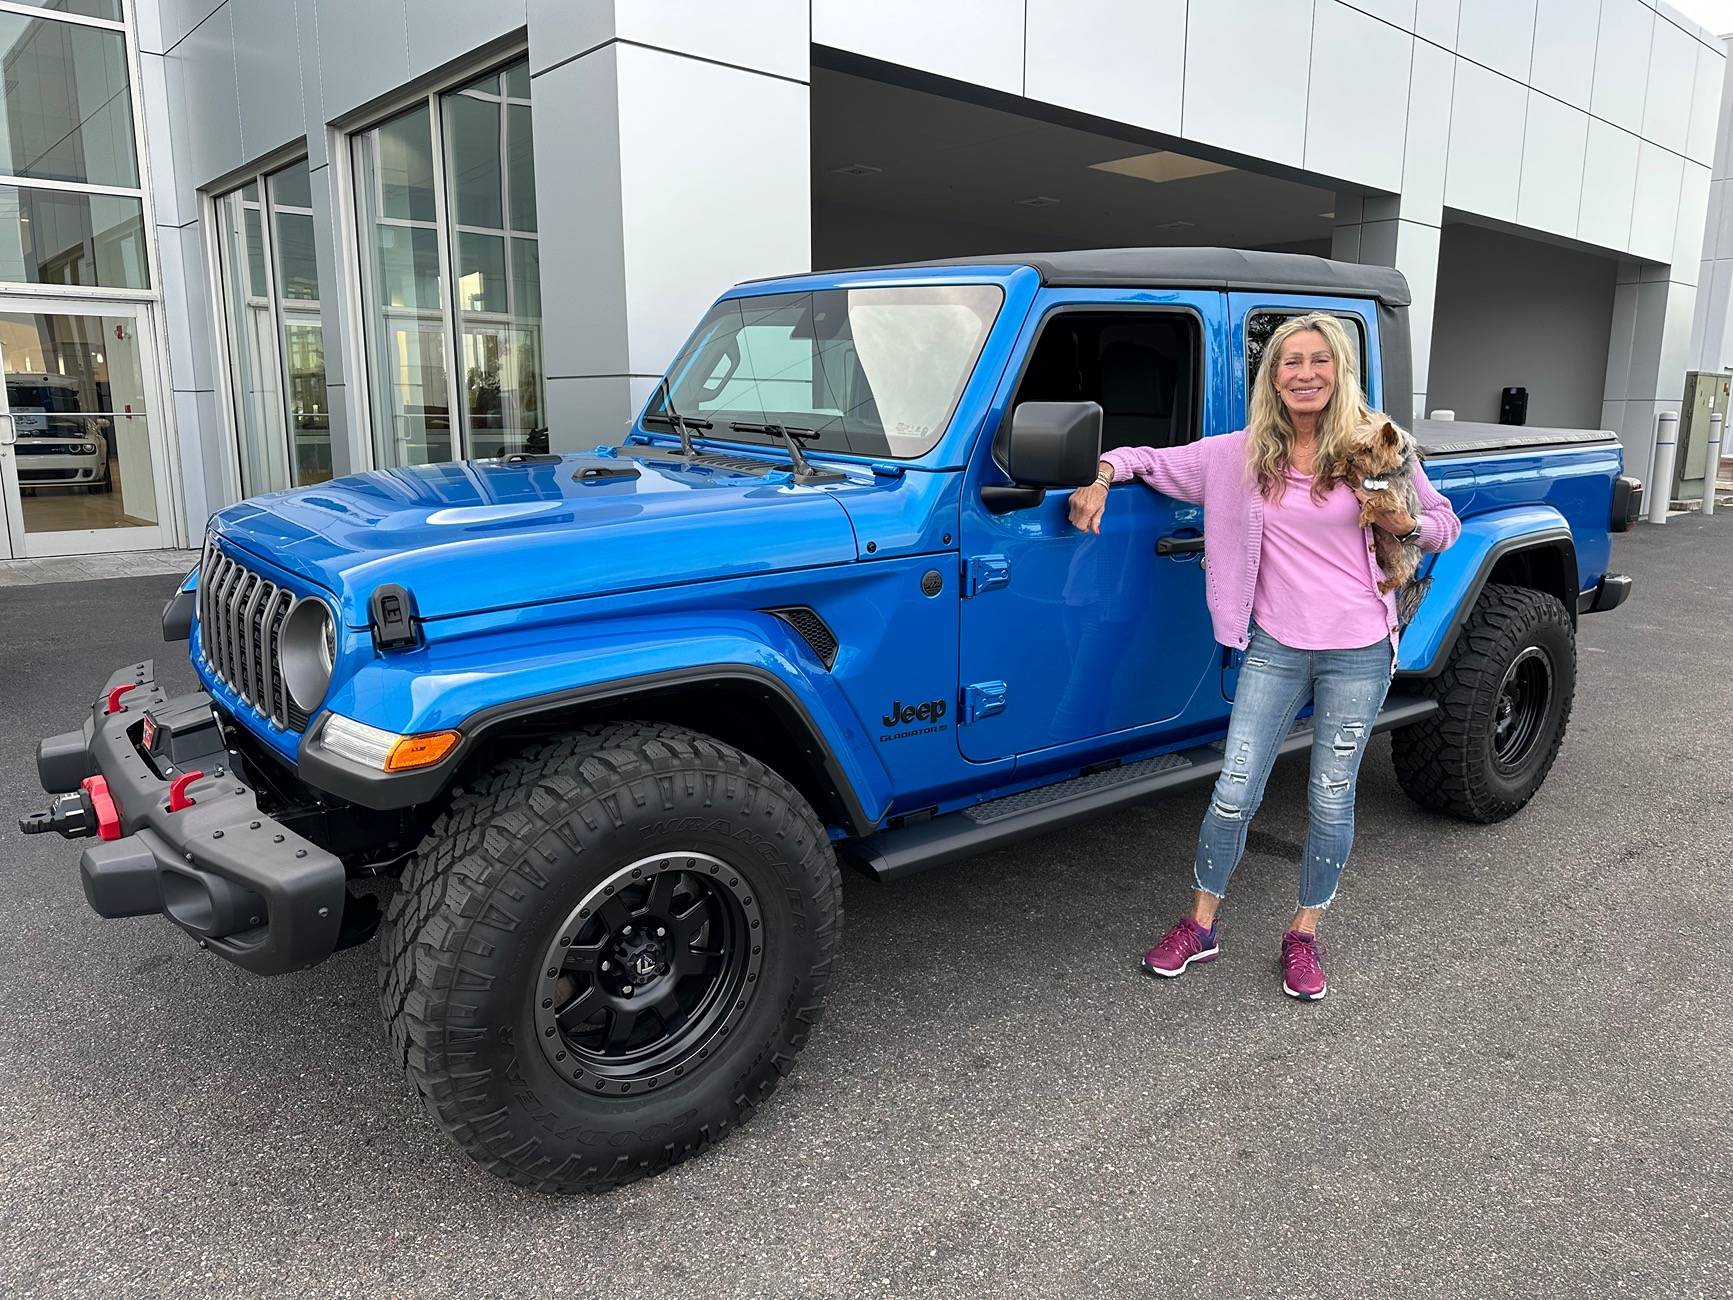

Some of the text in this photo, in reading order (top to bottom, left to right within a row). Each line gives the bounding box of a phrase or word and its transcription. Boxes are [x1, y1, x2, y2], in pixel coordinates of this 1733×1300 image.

[882, 699, 947, 727] Jeep
[880, 726, 938, 742] GLADIATOR
[639, 815, 807, 937] WRANGLER
